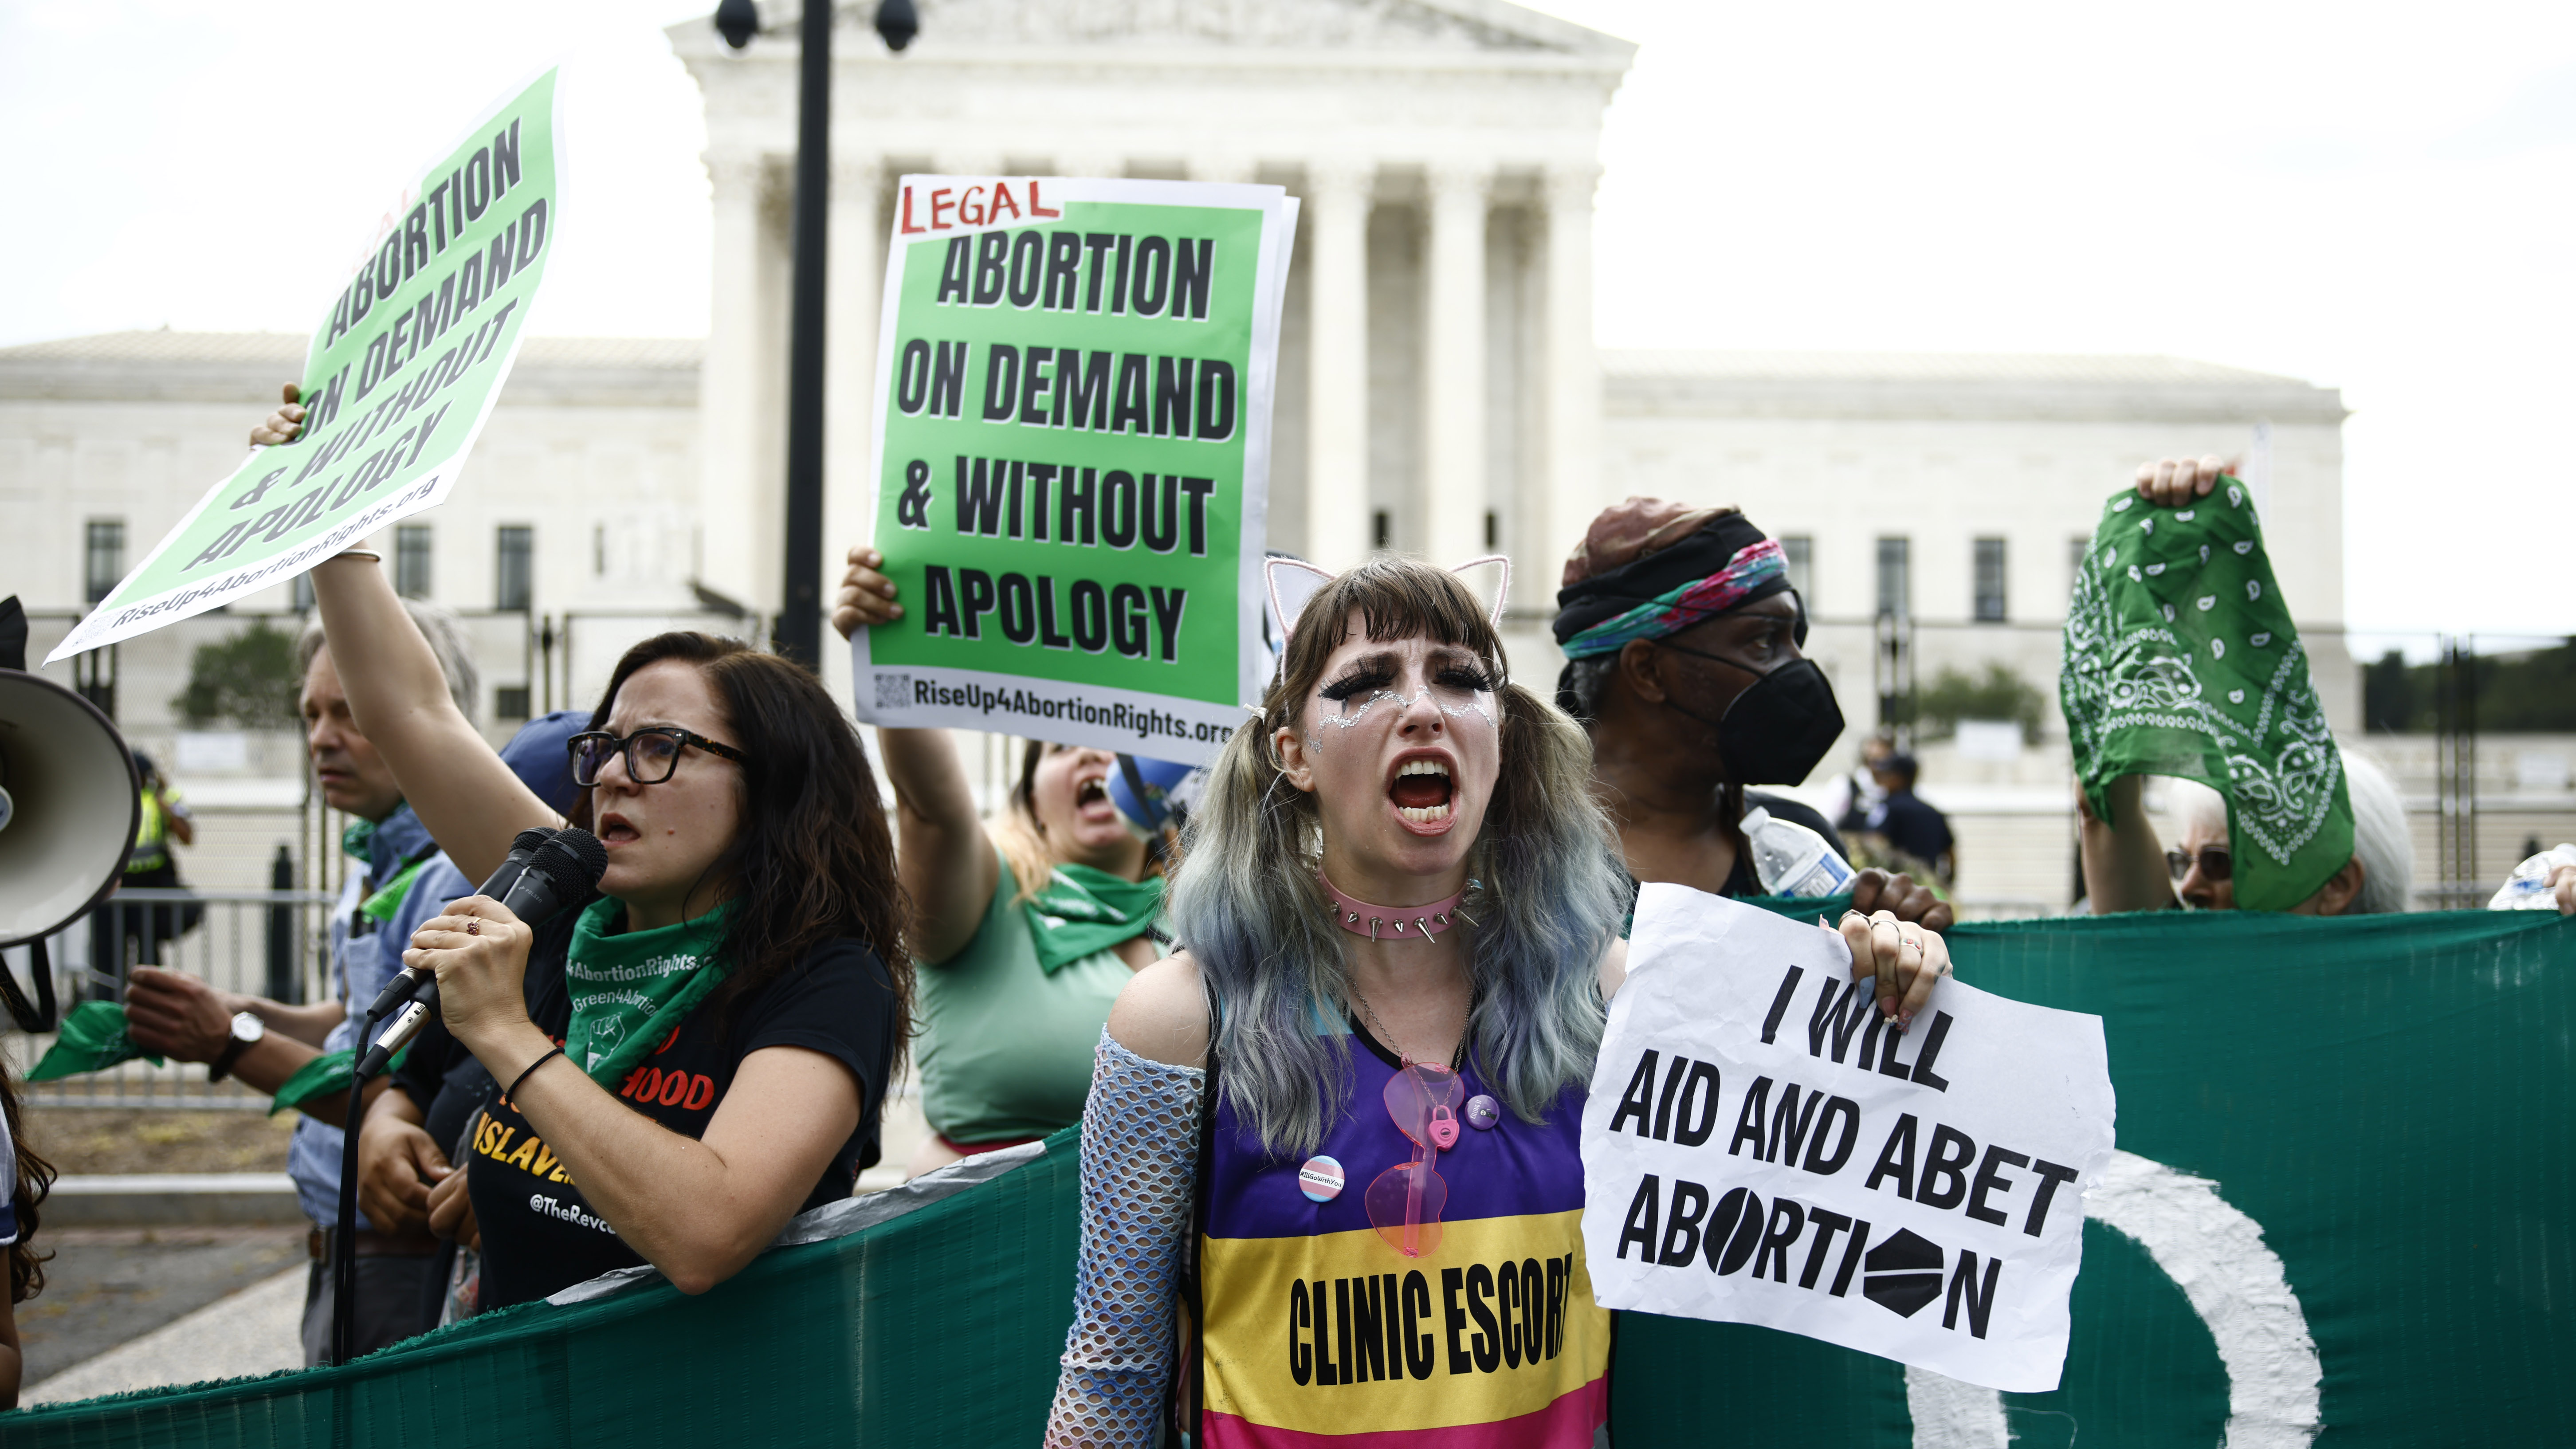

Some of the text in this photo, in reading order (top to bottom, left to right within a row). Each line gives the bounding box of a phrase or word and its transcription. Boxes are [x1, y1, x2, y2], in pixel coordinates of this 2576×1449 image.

[326, 116, 522, 350] ABORTION
[901, 181, 1060, 234] LEGAL
[280, 197, 548, 447] ON DEMAND
[936, 230, 1216, 322] ABORTION
[229, 297, 520, 510] & WITHOUT
[898, 338, 1238, 443] ON DEMAND
[180, 398, 456, 573] APOLOGY
[898, 456, 1216, 557] & WITHOUT
[111, 475, 439, 629] RiseUp4AbortionRights.org
[925, 565, 1186, 664] APOLOGY
[1760, 965, 1953, 1093] I WILL
[1469, 1104, 1480, 1119] KILLING
[1609, 1048, 2080, 1238] AID AND ABET
[1300, 1171, 1342, 1187] #IllGoWithYou
[1289, 1252, 1572, 1386] CLINIC ESCORT
